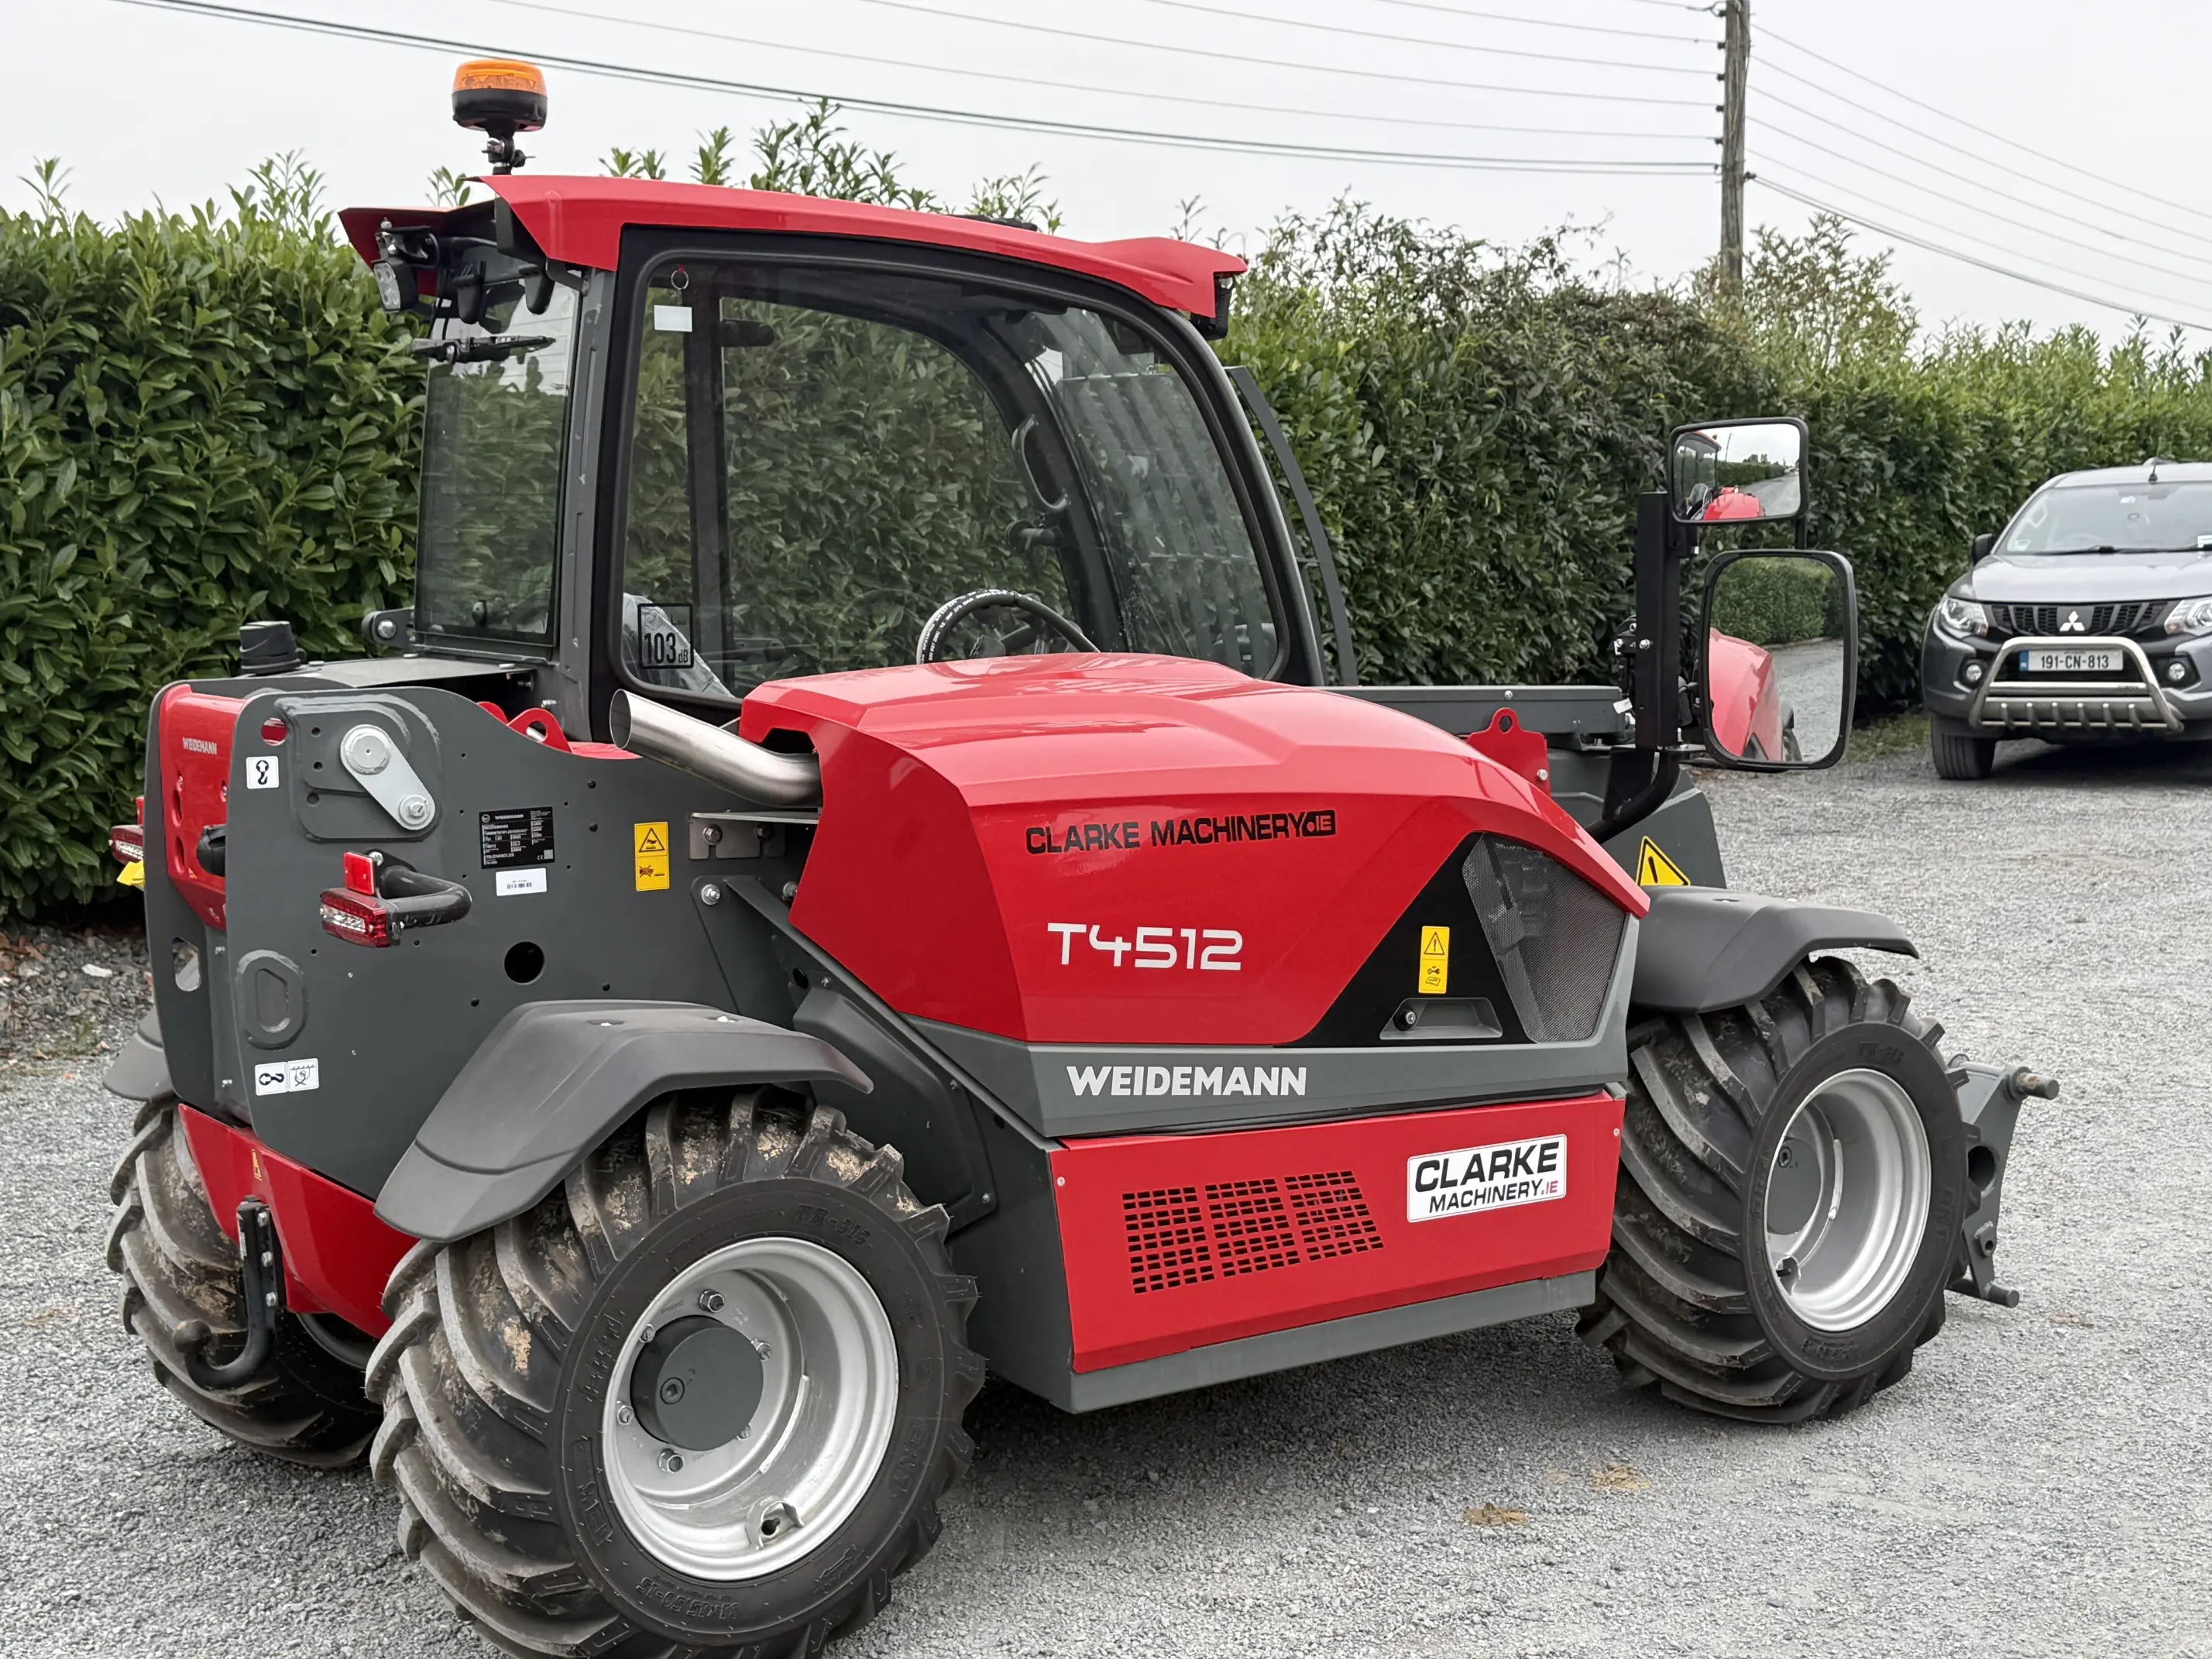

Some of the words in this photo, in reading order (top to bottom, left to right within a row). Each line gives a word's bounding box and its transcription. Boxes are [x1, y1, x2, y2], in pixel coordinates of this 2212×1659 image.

[644, 632, 676, 664] 103
[678, 649, 688, 664] dB
[2041, 654, 2109, 669] 191-CN-813
[1026, 821, 1140, 854] CLARKE
[1047, 922, 1243, 971] T4512
[1066, 1066, 1307, 1096] WEIDEMANN
[1415, 1141, 1560, 1193] CLARKE
[1429, 1178, 1559, 1214] MACHINERY.IE
